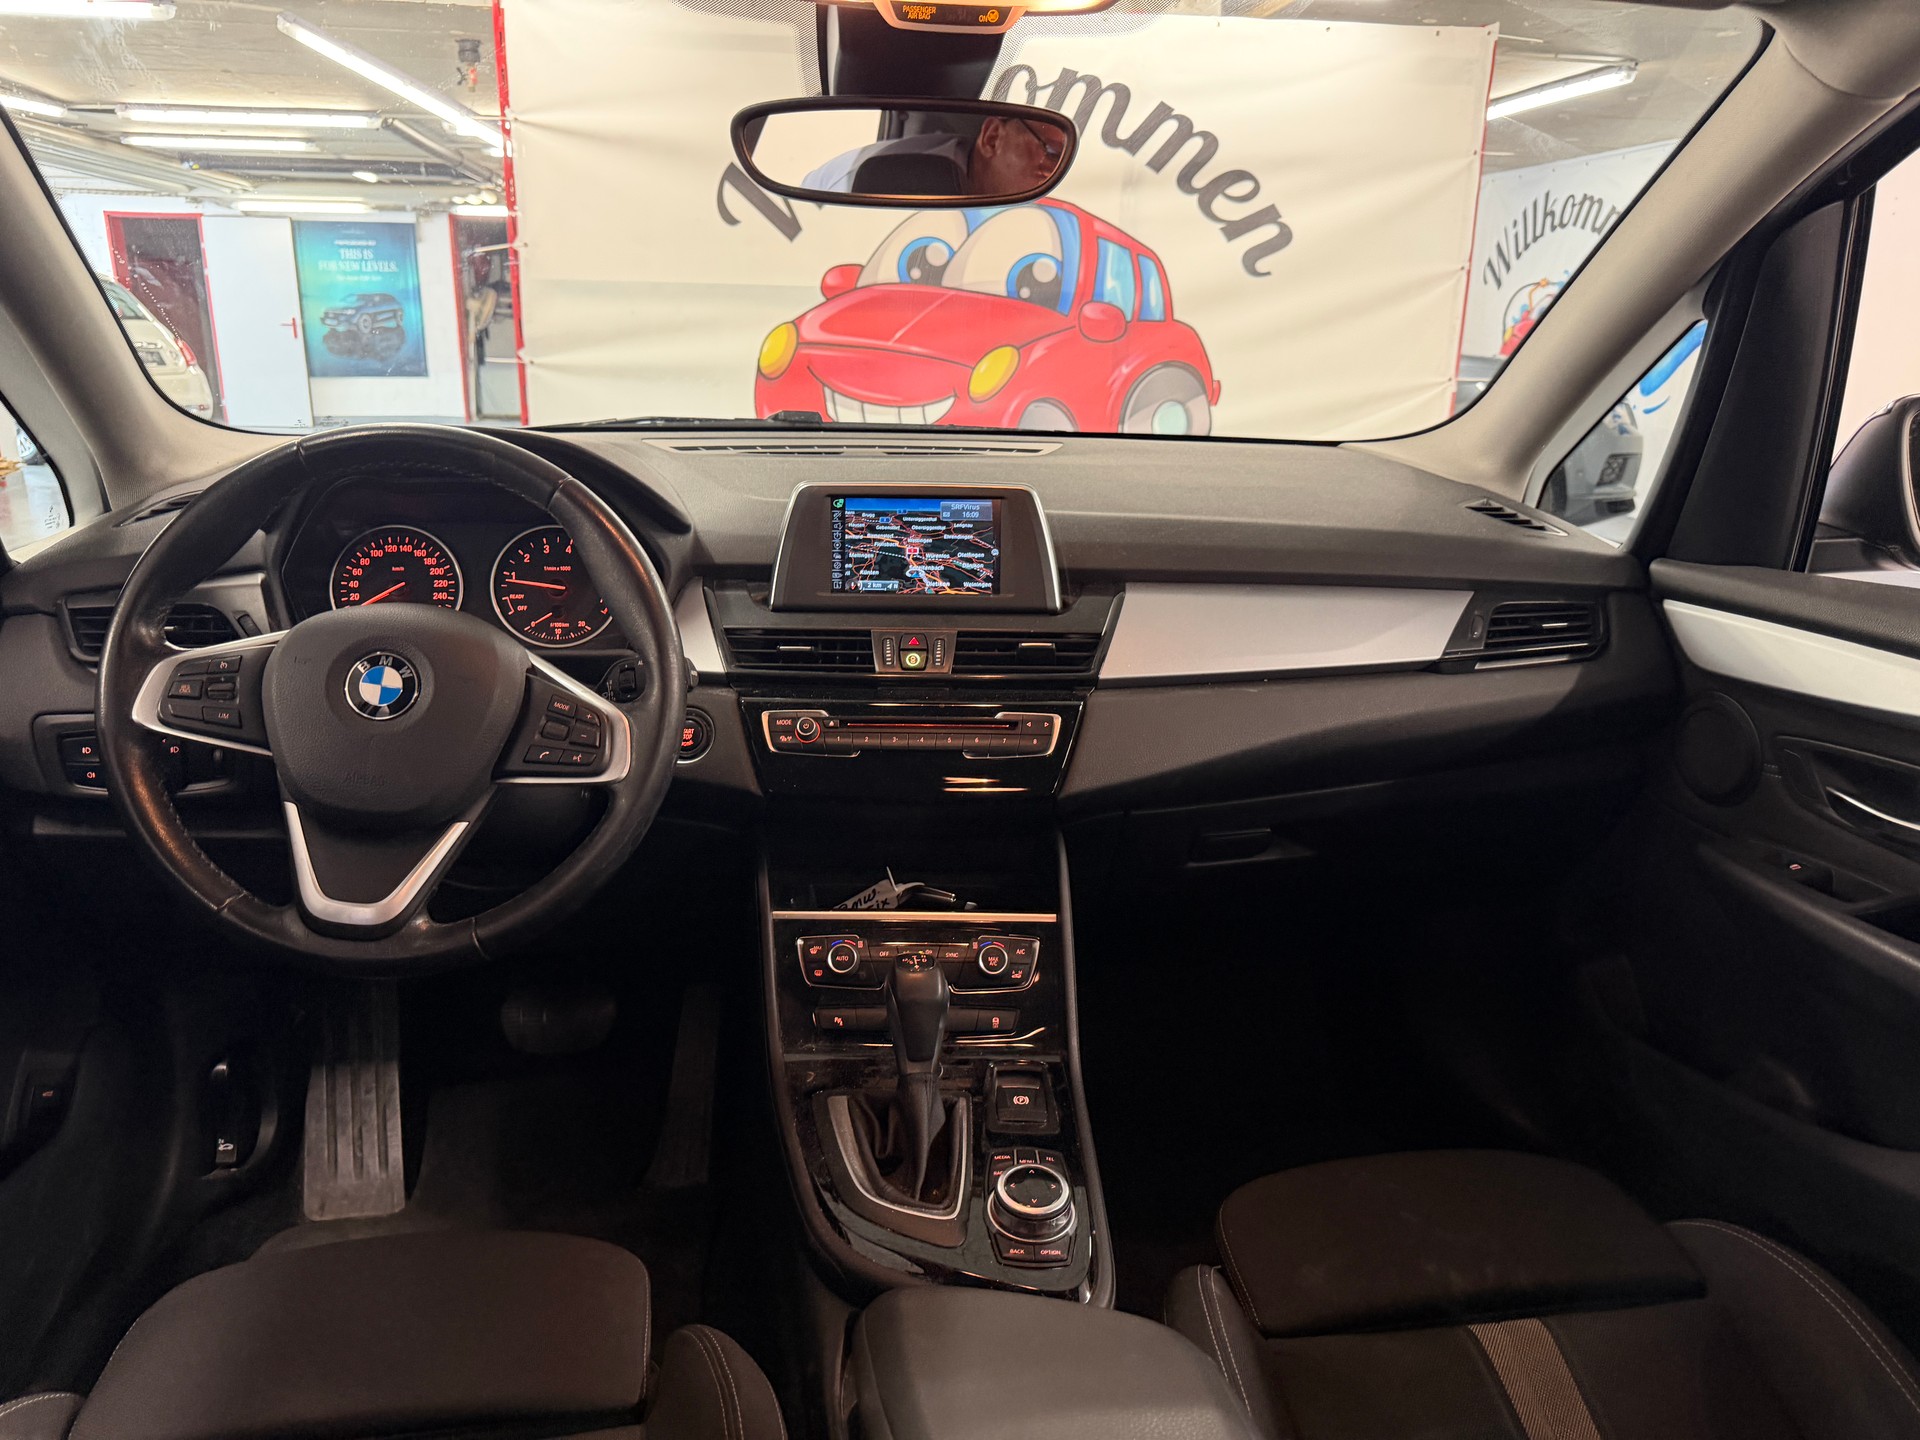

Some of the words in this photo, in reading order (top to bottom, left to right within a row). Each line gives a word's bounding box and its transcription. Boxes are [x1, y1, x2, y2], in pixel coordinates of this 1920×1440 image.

[902, 5, 937, 14] PASSENGER
[339, 248, 362, 259] THIS
[363, 249, 374, 259] IS
[370, 549, 383, 557] 100
[413, 549, 427, 557] 160
[543, 545, 550, 554] 3
[565, 545, 572, 554] 4
[360, 557, 370, 565] 80
[424, 557, 437, 565] 180
[523, 553, 530, 562] 2
[352, 568, 363, 576] 60
[429, 567, 444, 576] 200
[511, 571, 516, 580] 1
[348, 580, 359, 588] 40
[433, 592, 448, 600] 240
[357, 655, 413, 679] BMW
[553, 701, 570, 711] MODE
